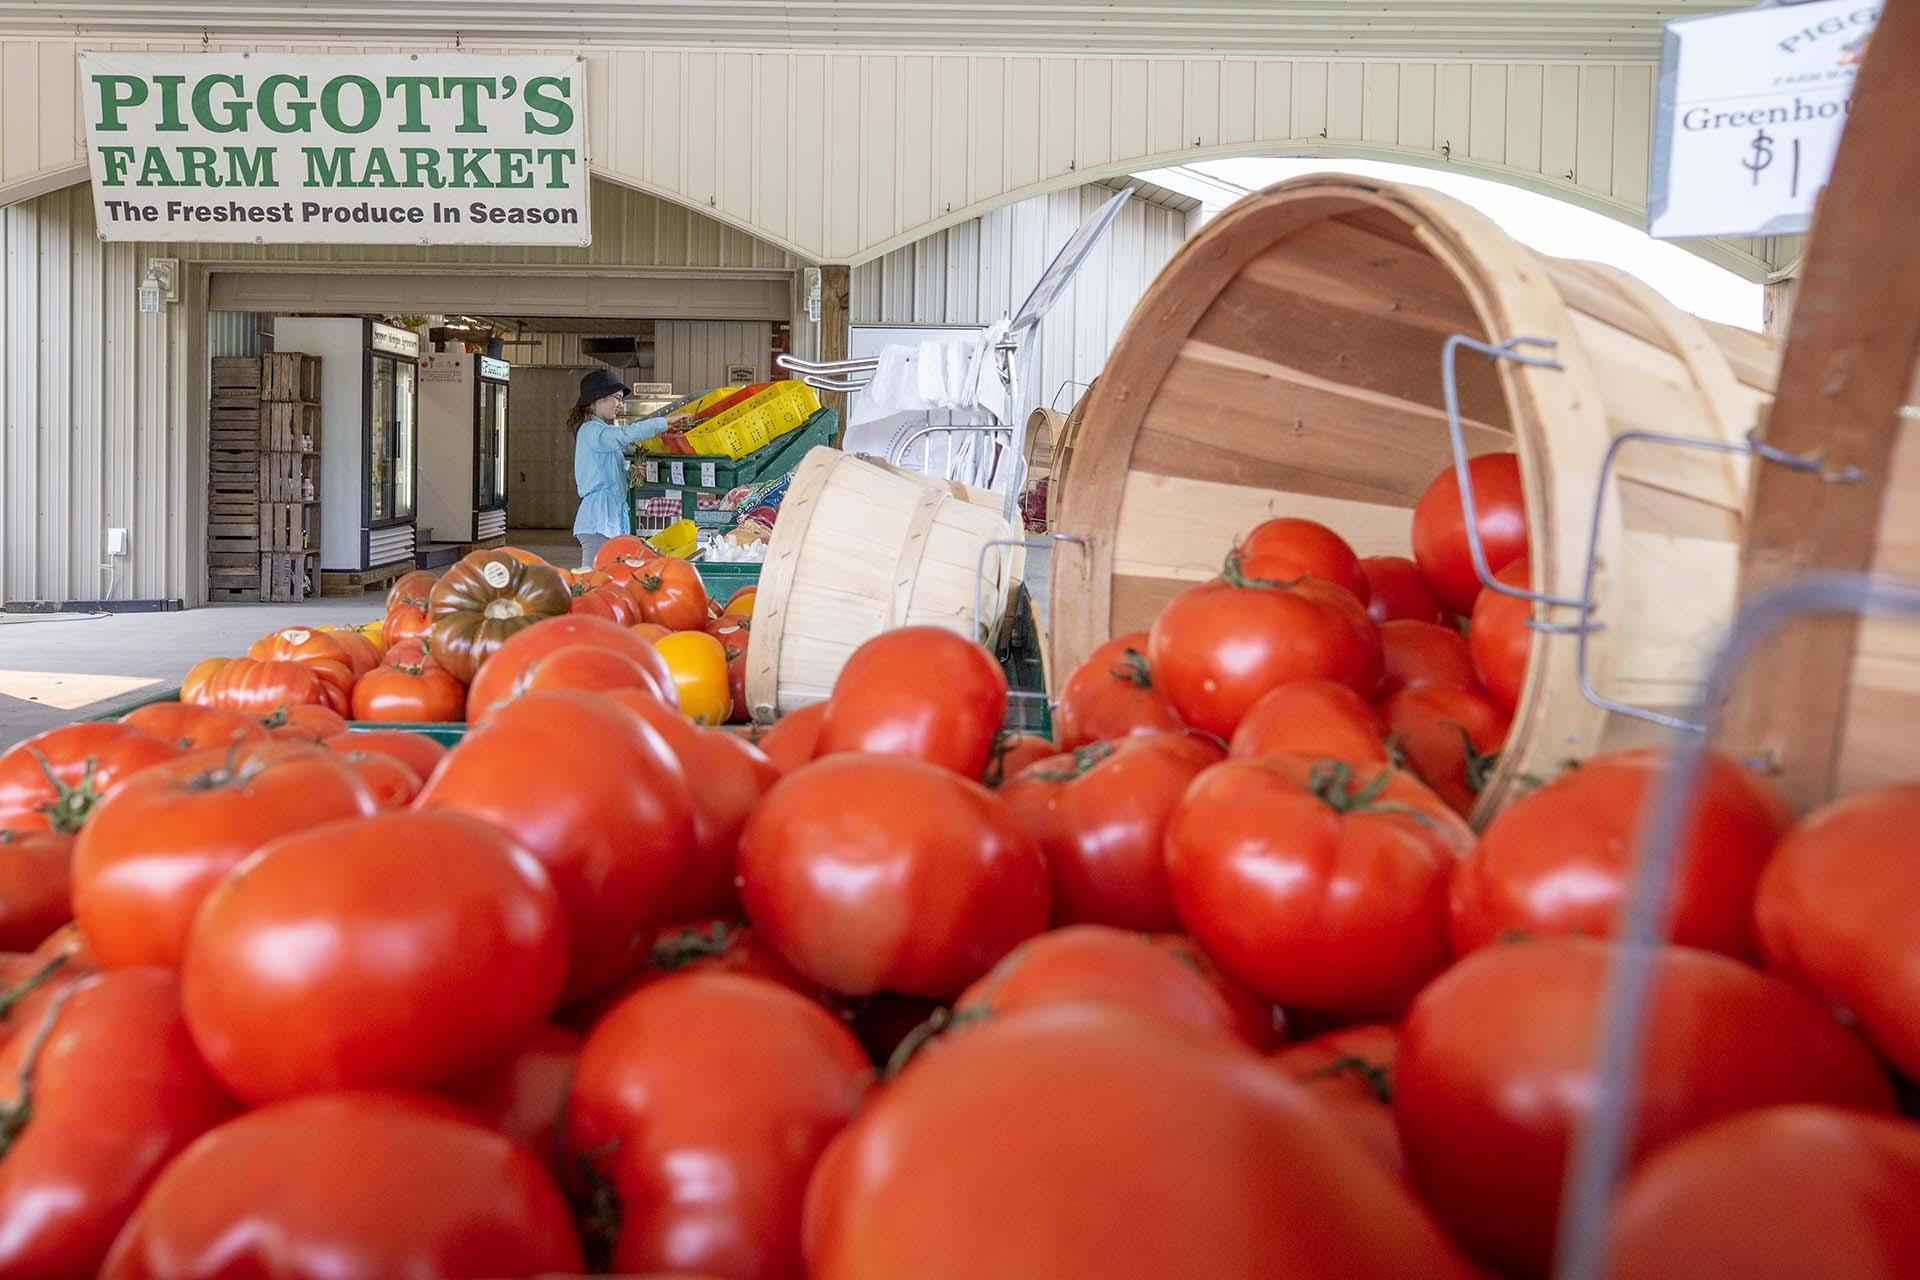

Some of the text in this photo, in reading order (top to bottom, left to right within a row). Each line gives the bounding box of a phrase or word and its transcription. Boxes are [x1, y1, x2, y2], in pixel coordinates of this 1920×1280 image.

[1778, 6, 1878, 54] PIGG
[91, 74, 575, 135] PIGGOTT'S
[97, 145, 576, 190] FARM MARKET
[104, 200, 579, 225] The Freshest Produce In Season
